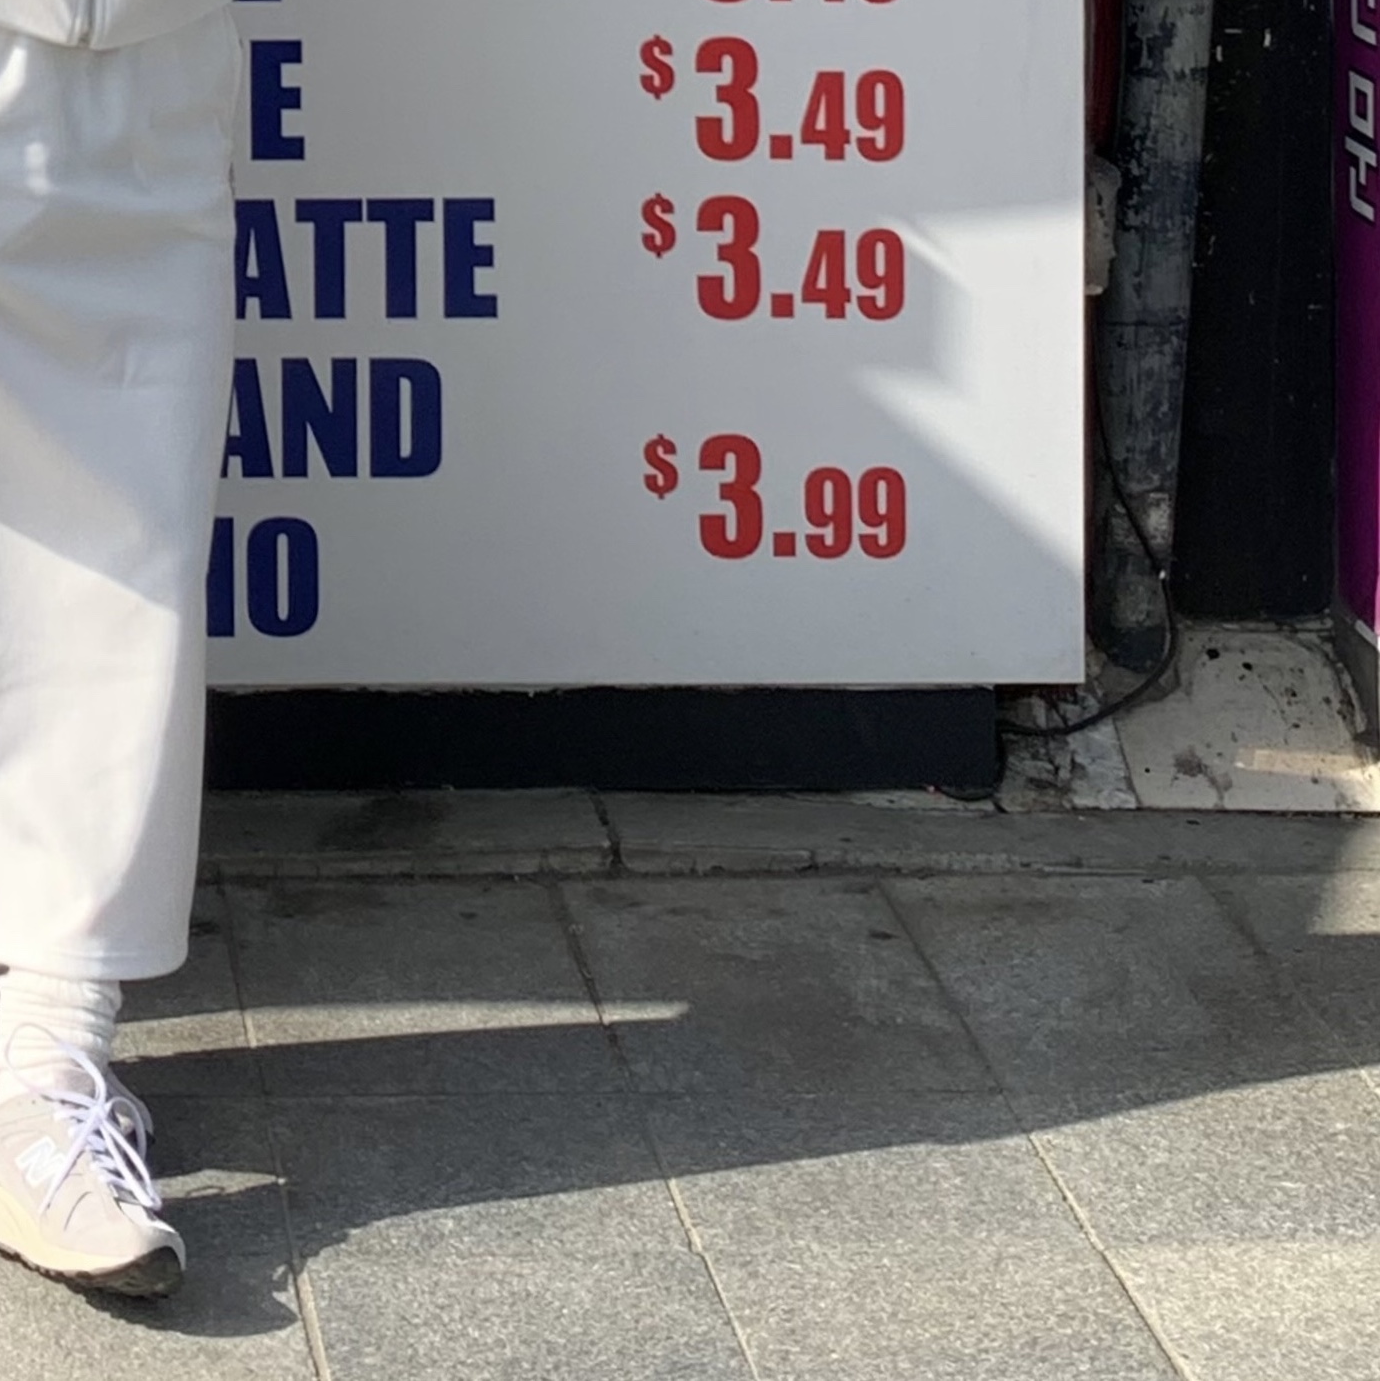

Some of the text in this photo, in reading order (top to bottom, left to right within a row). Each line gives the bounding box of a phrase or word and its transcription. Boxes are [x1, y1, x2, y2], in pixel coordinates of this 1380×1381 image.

[640, 35, 906, 163] $3.49
[641, 194, 907, 322] $3.49
[643, 434, 908, 560] $3.99
